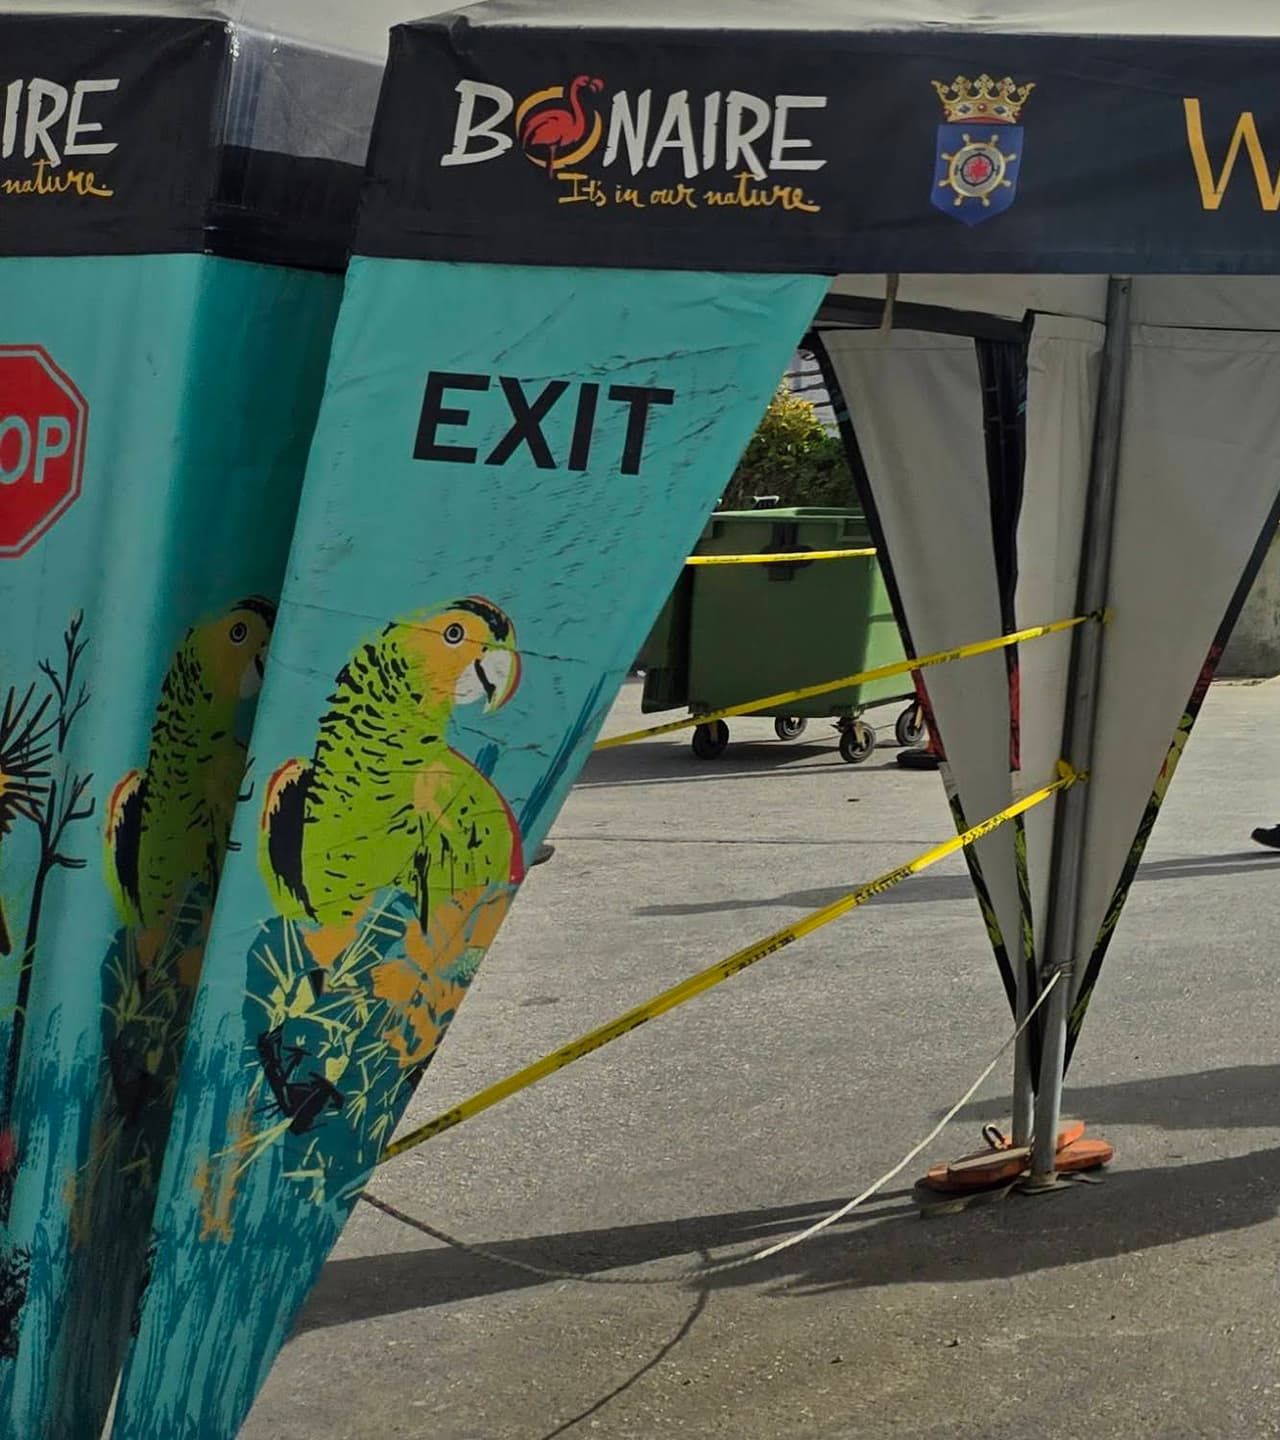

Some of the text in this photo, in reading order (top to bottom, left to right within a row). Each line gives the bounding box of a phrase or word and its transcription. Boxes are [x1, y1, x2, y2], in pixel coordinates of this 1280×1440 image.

[439, 74, 829, 181] BONAIRE
[556, 172, 607, 208] It's
[614, 183, 646, 208] in
[650, 182, 698, 209] our
[0, 415, 72, 485] OP
[411, 370, 675, 476] EXIT
